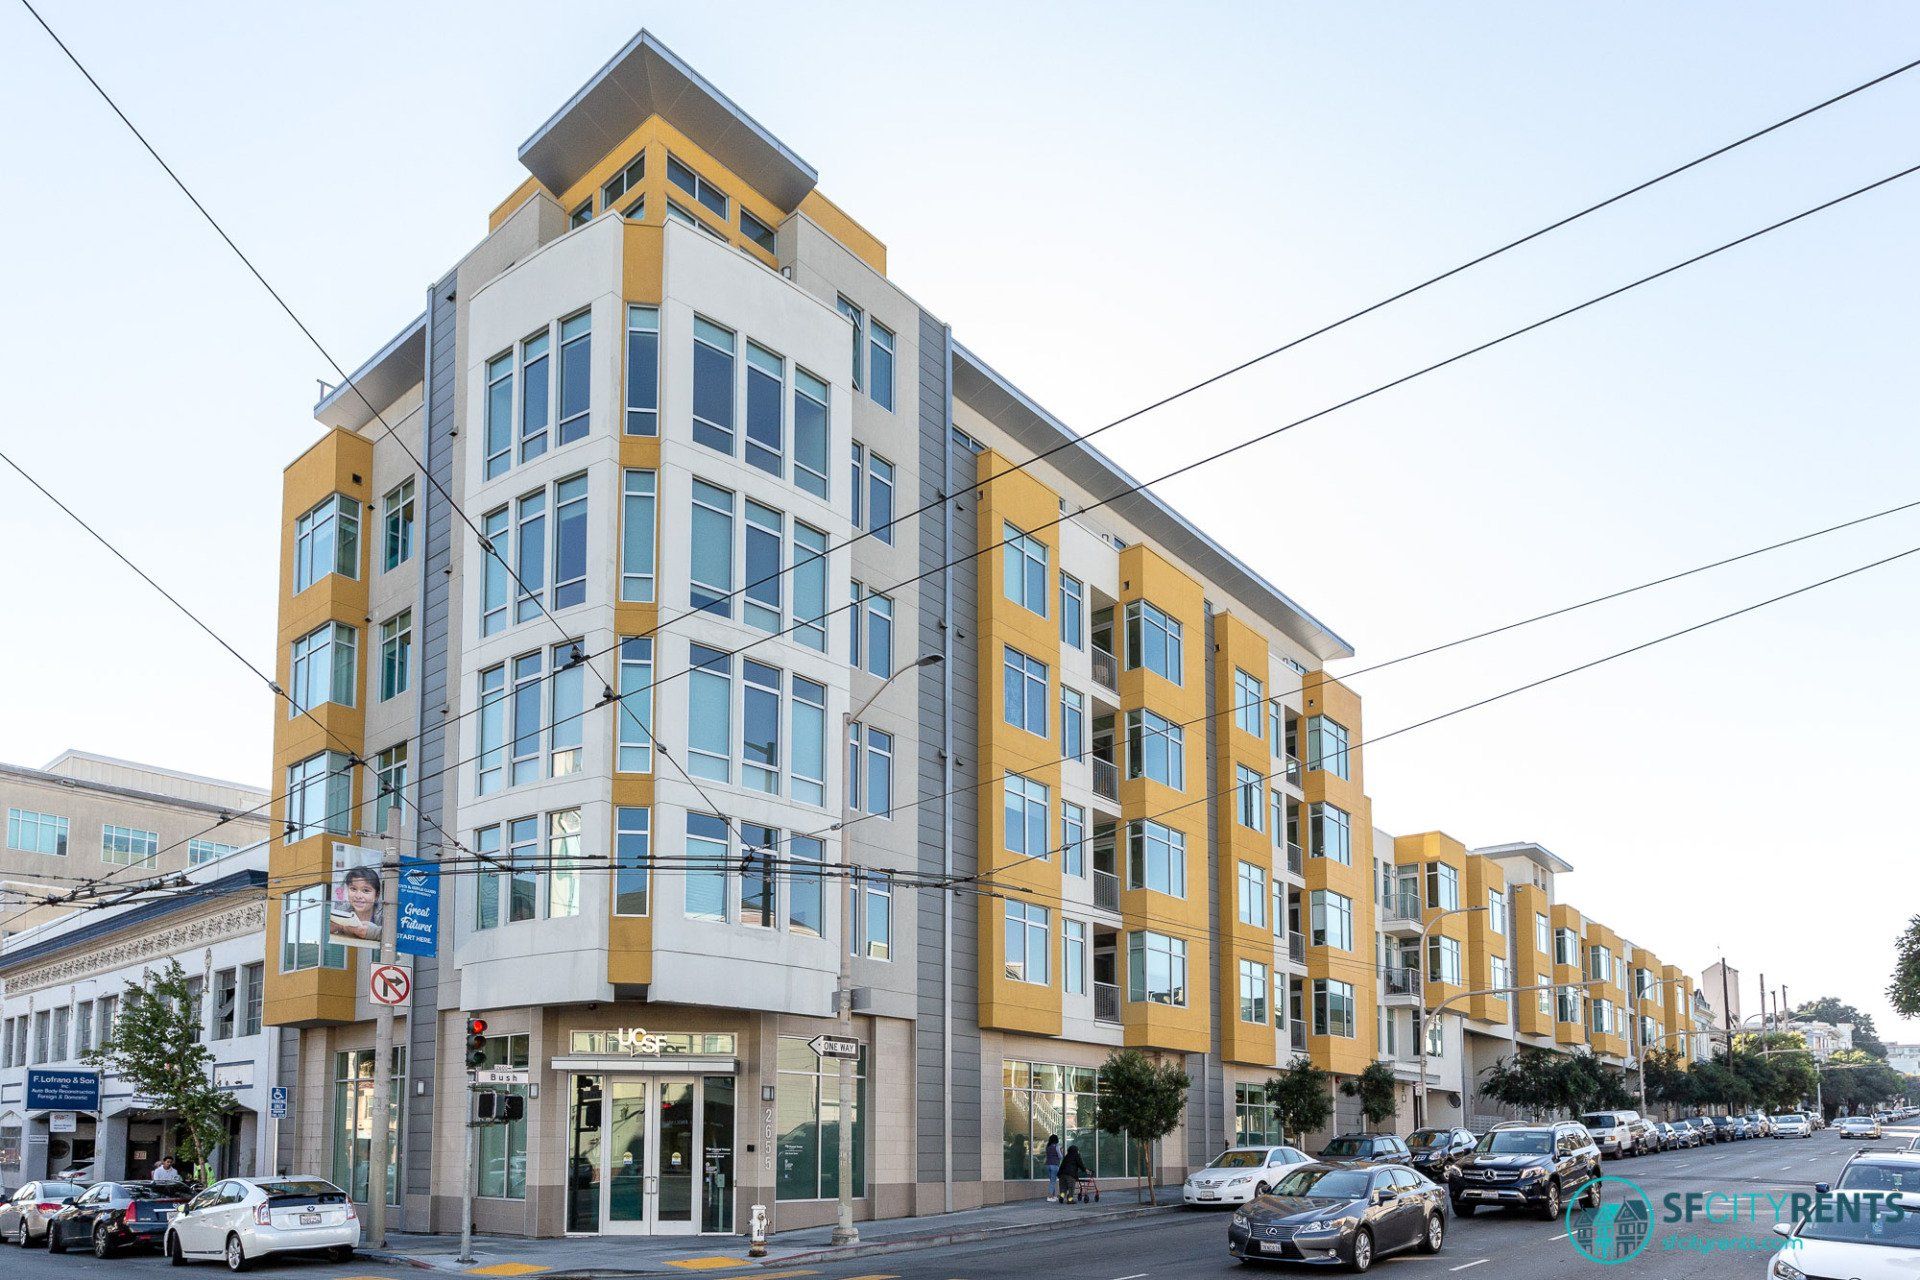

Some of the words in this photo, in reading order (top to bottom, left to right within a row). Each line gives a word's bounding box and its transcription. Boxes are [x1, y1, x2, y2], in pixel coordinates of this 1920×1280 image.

[404, 902, 430, 918] Great
[400, 916, 432, 932] Futures
[618, 1027, 667, 1053] UCSF
[824, 1042, 838, 1051] ONE
[840, 1044, 854, 1053] WAY
